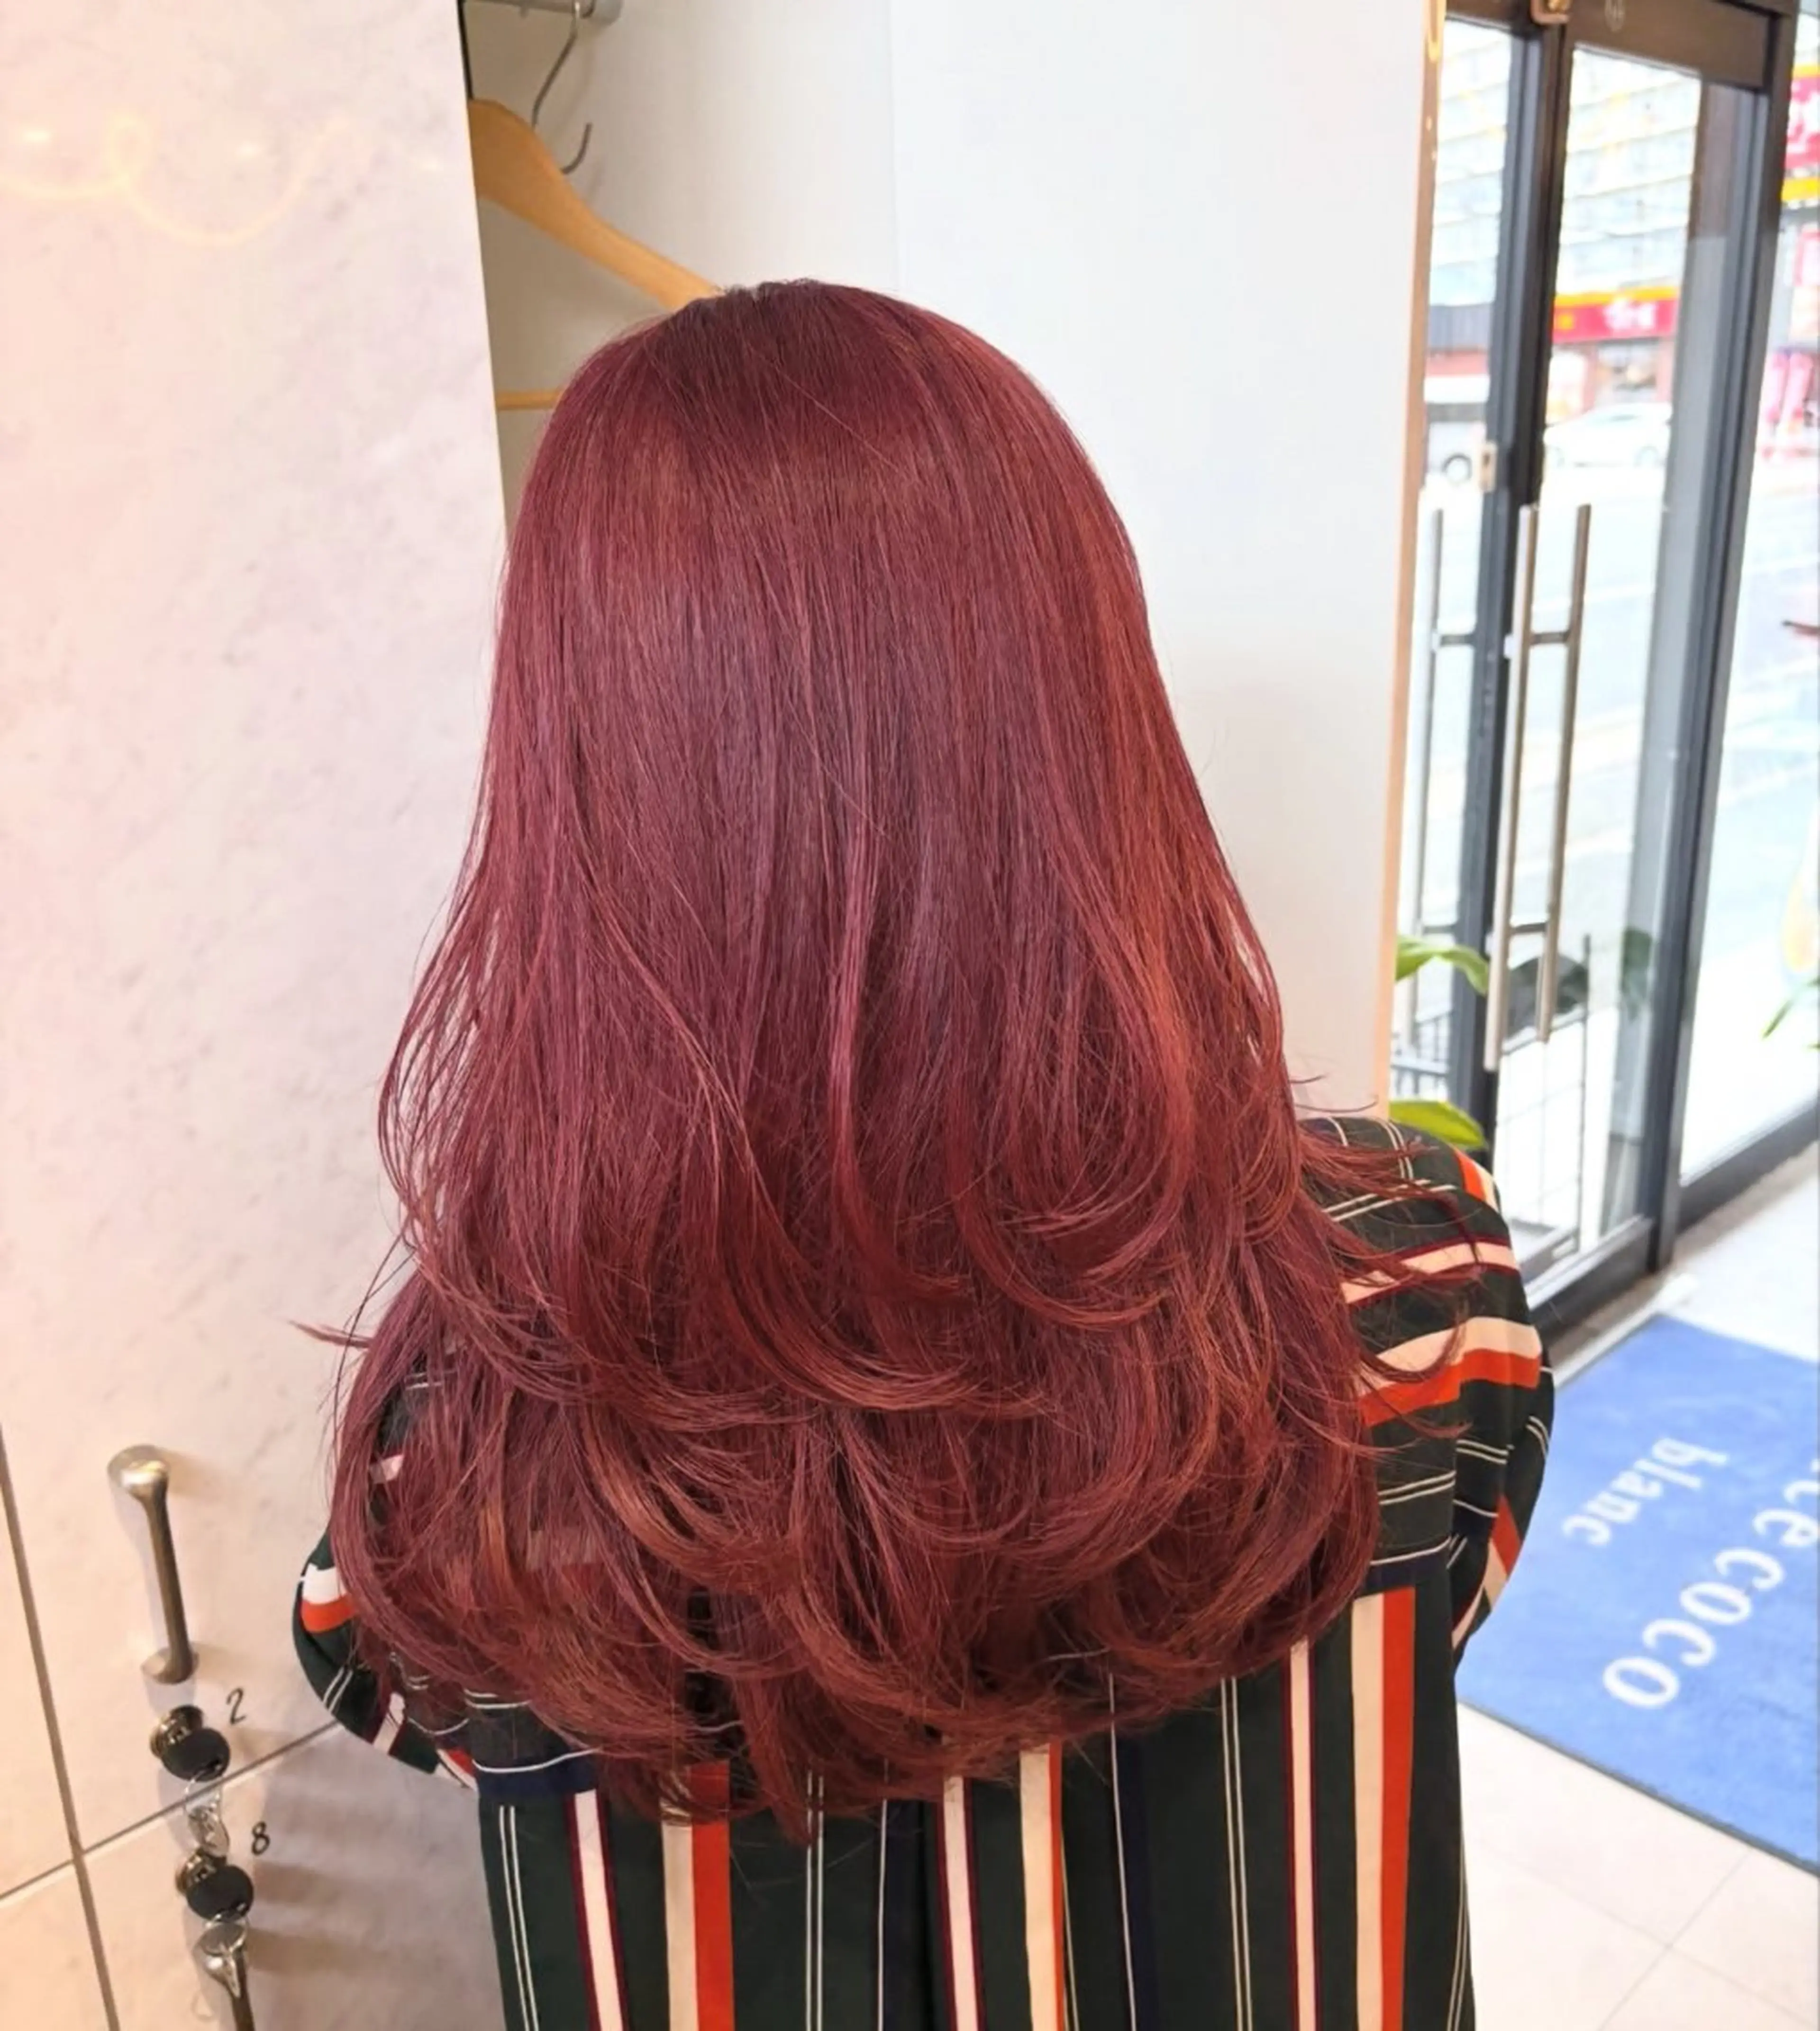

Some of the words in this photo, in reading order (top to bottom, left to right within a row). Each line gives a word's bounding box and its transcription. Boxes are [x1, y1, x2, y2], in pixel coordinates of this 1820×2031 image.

[1561, 1438, 1728, 1546] blanc
[1602, 1547, 1784, 1709] coco
[226, 1687, 246, 1725] 2
[251, 1820, 271, 1856] 8
